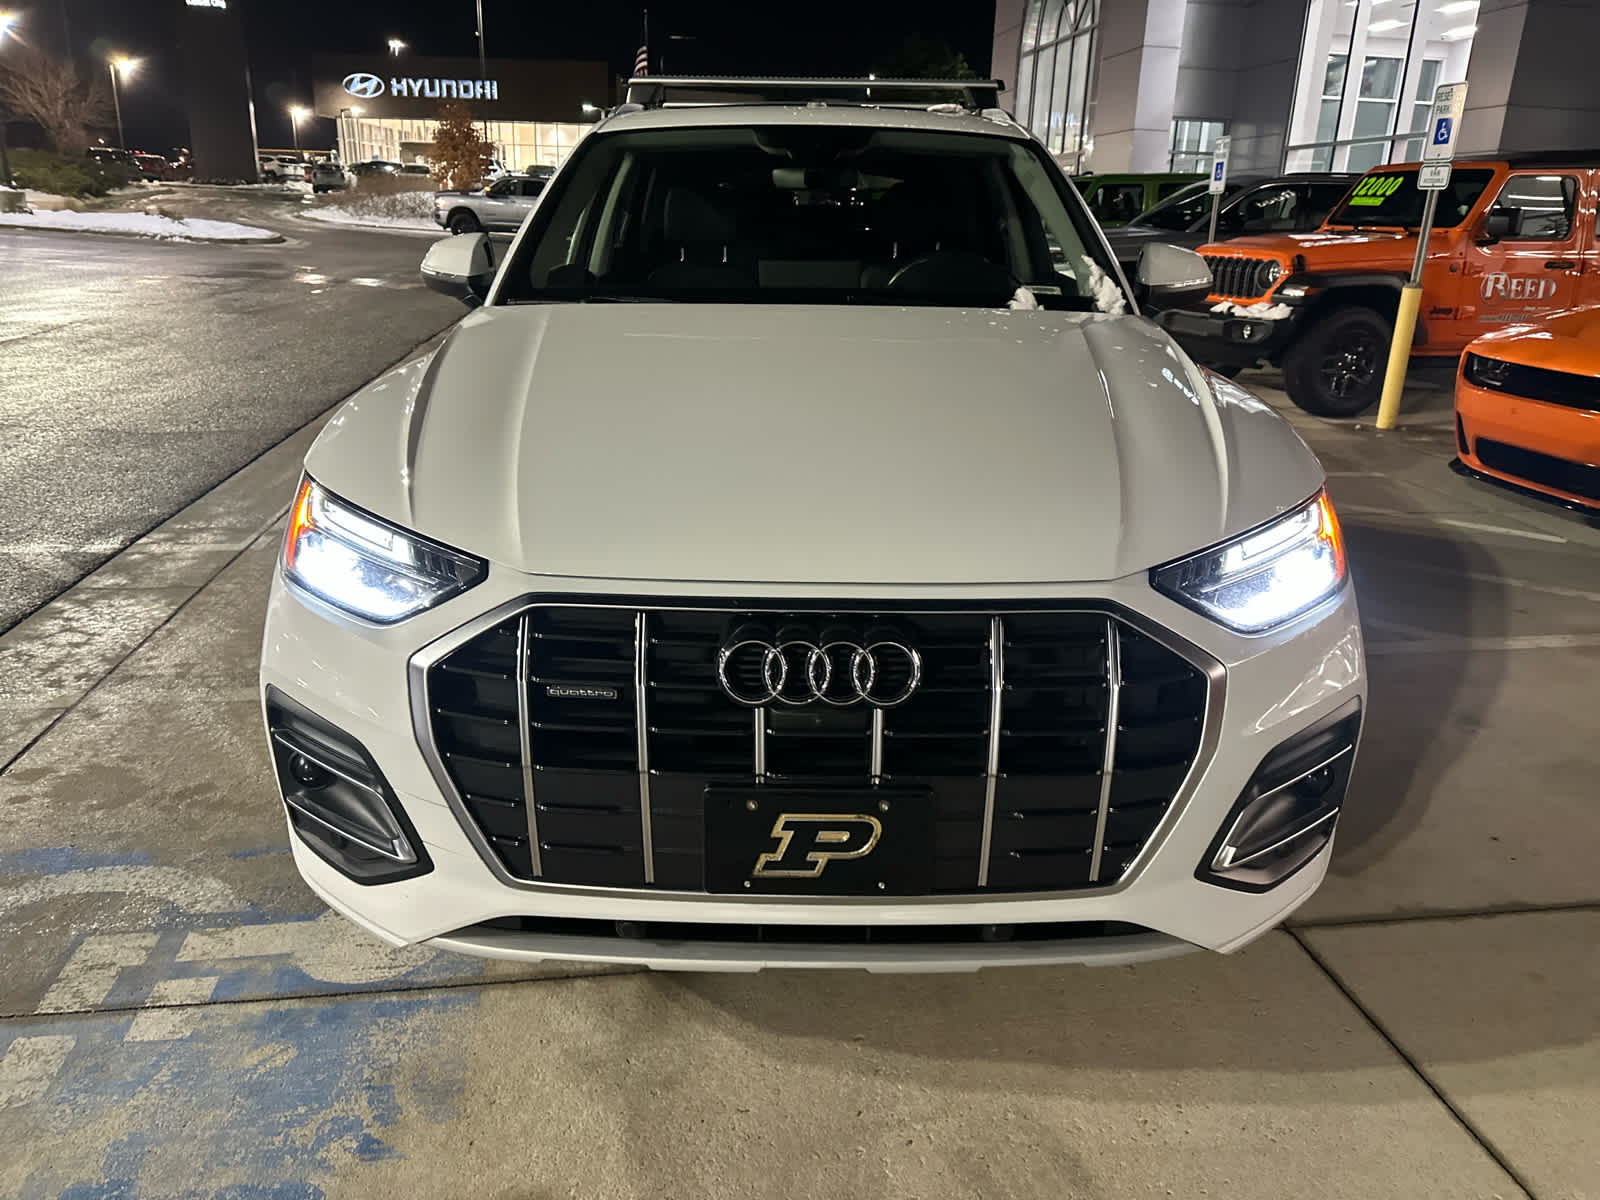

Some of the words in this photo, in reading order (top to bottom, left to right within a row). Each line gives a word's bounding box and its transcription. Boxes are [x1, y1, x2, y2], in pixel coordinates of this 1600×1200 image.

[391, 77, 498, 100] HYUNDAI
[1351, 176, 1404, 196] 12000
[1481, 271, 1557, 301] REED
[549, 687, 613, 697] quattro
